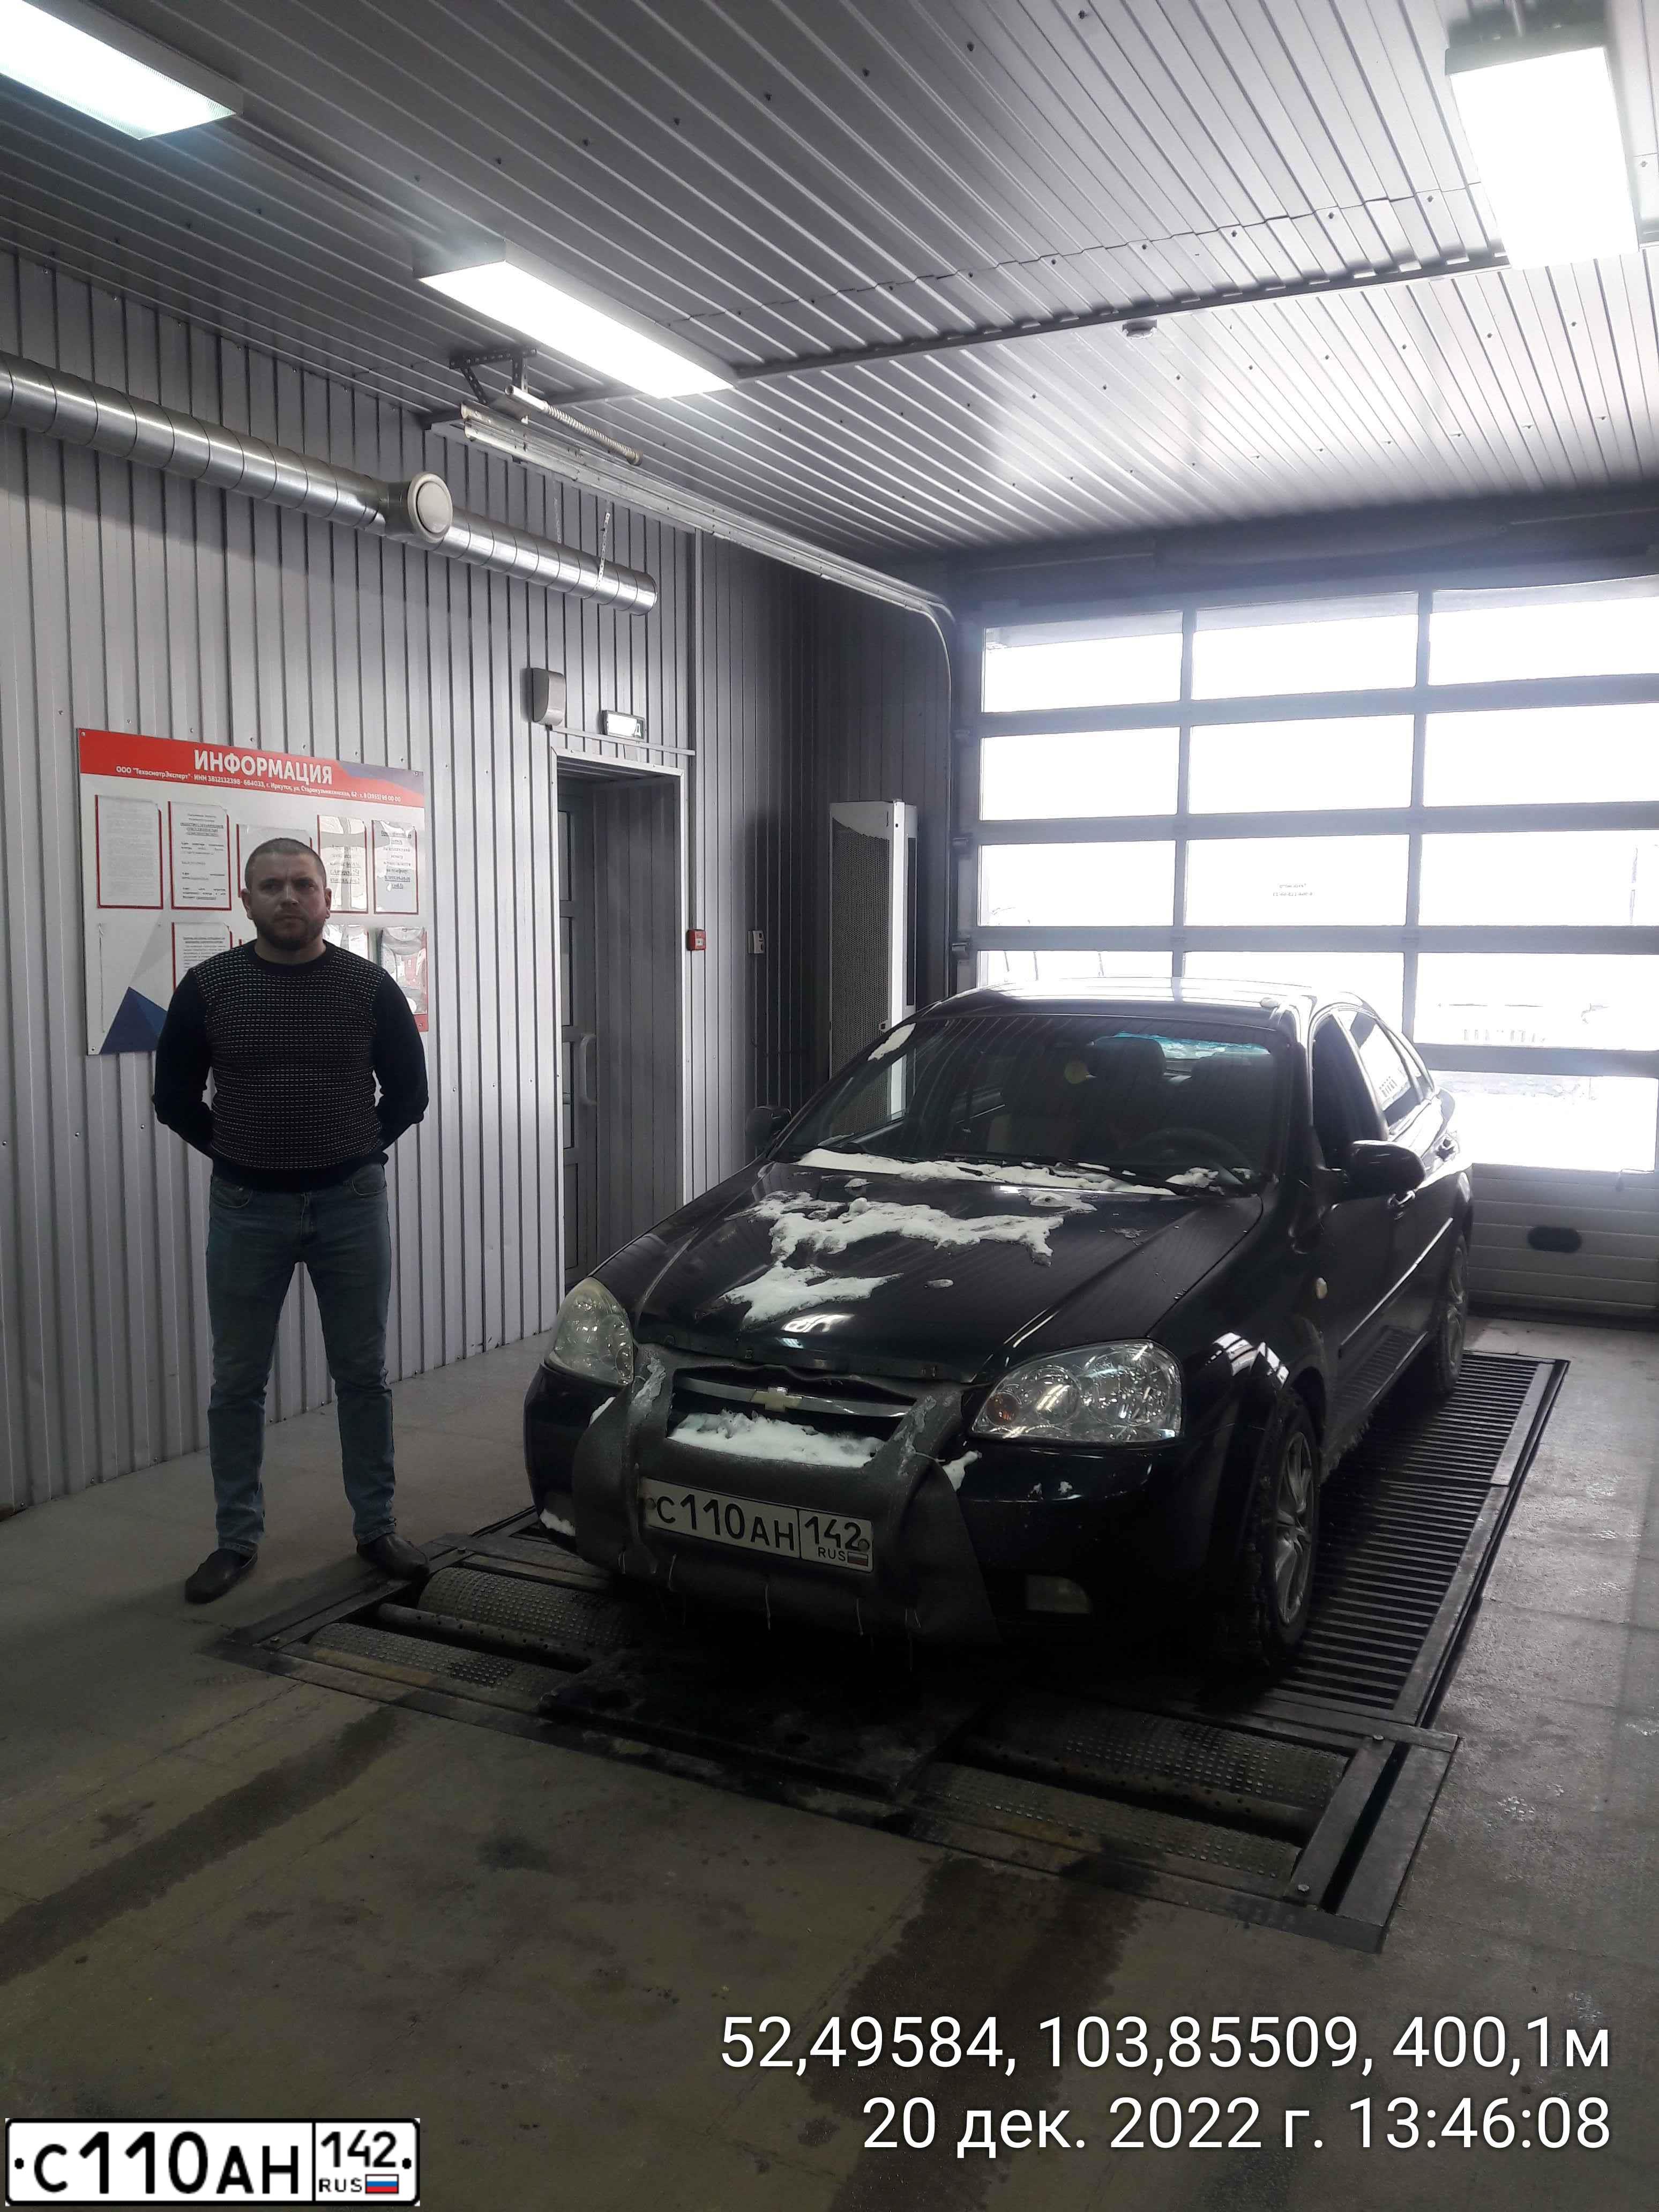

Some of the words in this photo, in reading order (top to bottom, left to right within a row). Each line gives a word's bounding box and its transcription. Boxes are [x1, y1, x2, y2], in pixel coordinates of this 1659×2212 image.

[116, 766, 131, 774] ООО
[194, 749, 332, 785] ИНФОРМАЦИЯ
[656, 1493, 795, 1551] С110АН
[804, 1515, 864, 1551] 142
[818, 1547, 846, 1562] RUS
